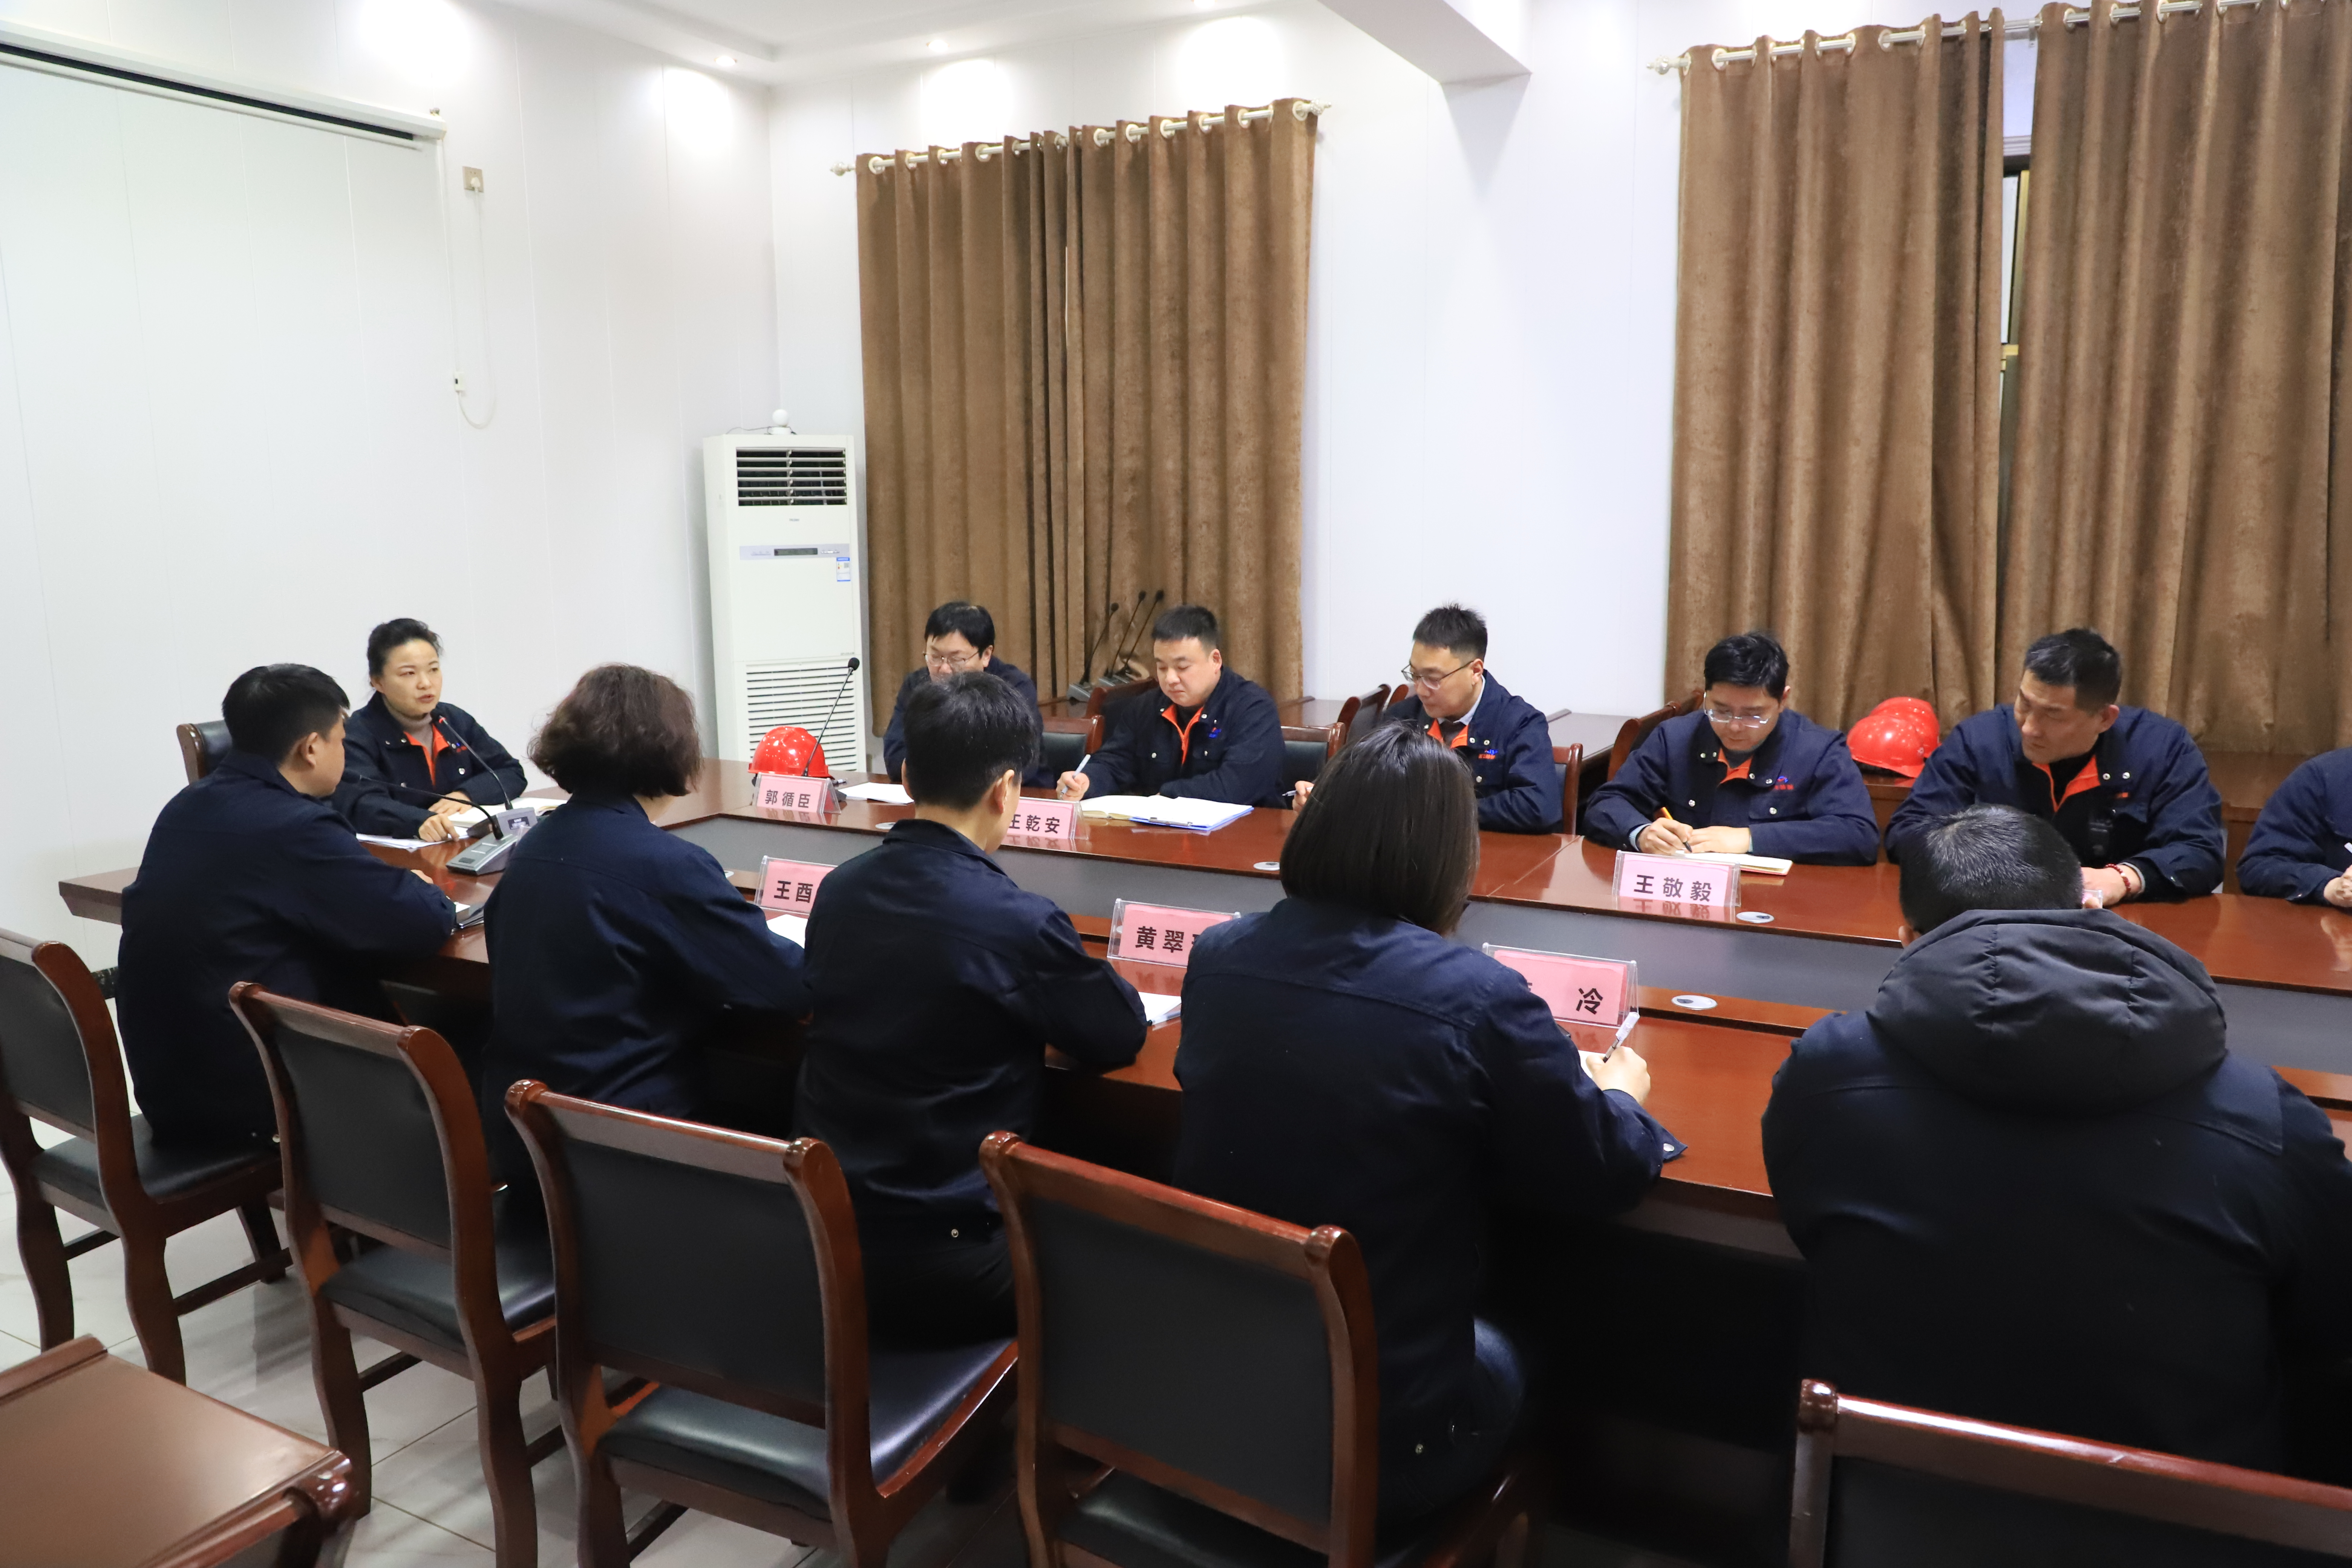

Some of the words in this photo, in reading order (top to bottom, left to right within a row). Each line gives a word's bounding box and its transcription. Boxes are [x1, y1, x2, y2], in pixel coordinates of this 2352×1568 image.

[765, 789, 811, 808] 郭循臣
[1009, 814, 1060, 834] 王乾安
[1633, 874, 1712, 902] 王敬毅
[1135, 926, 1200, 953] 黄翠
